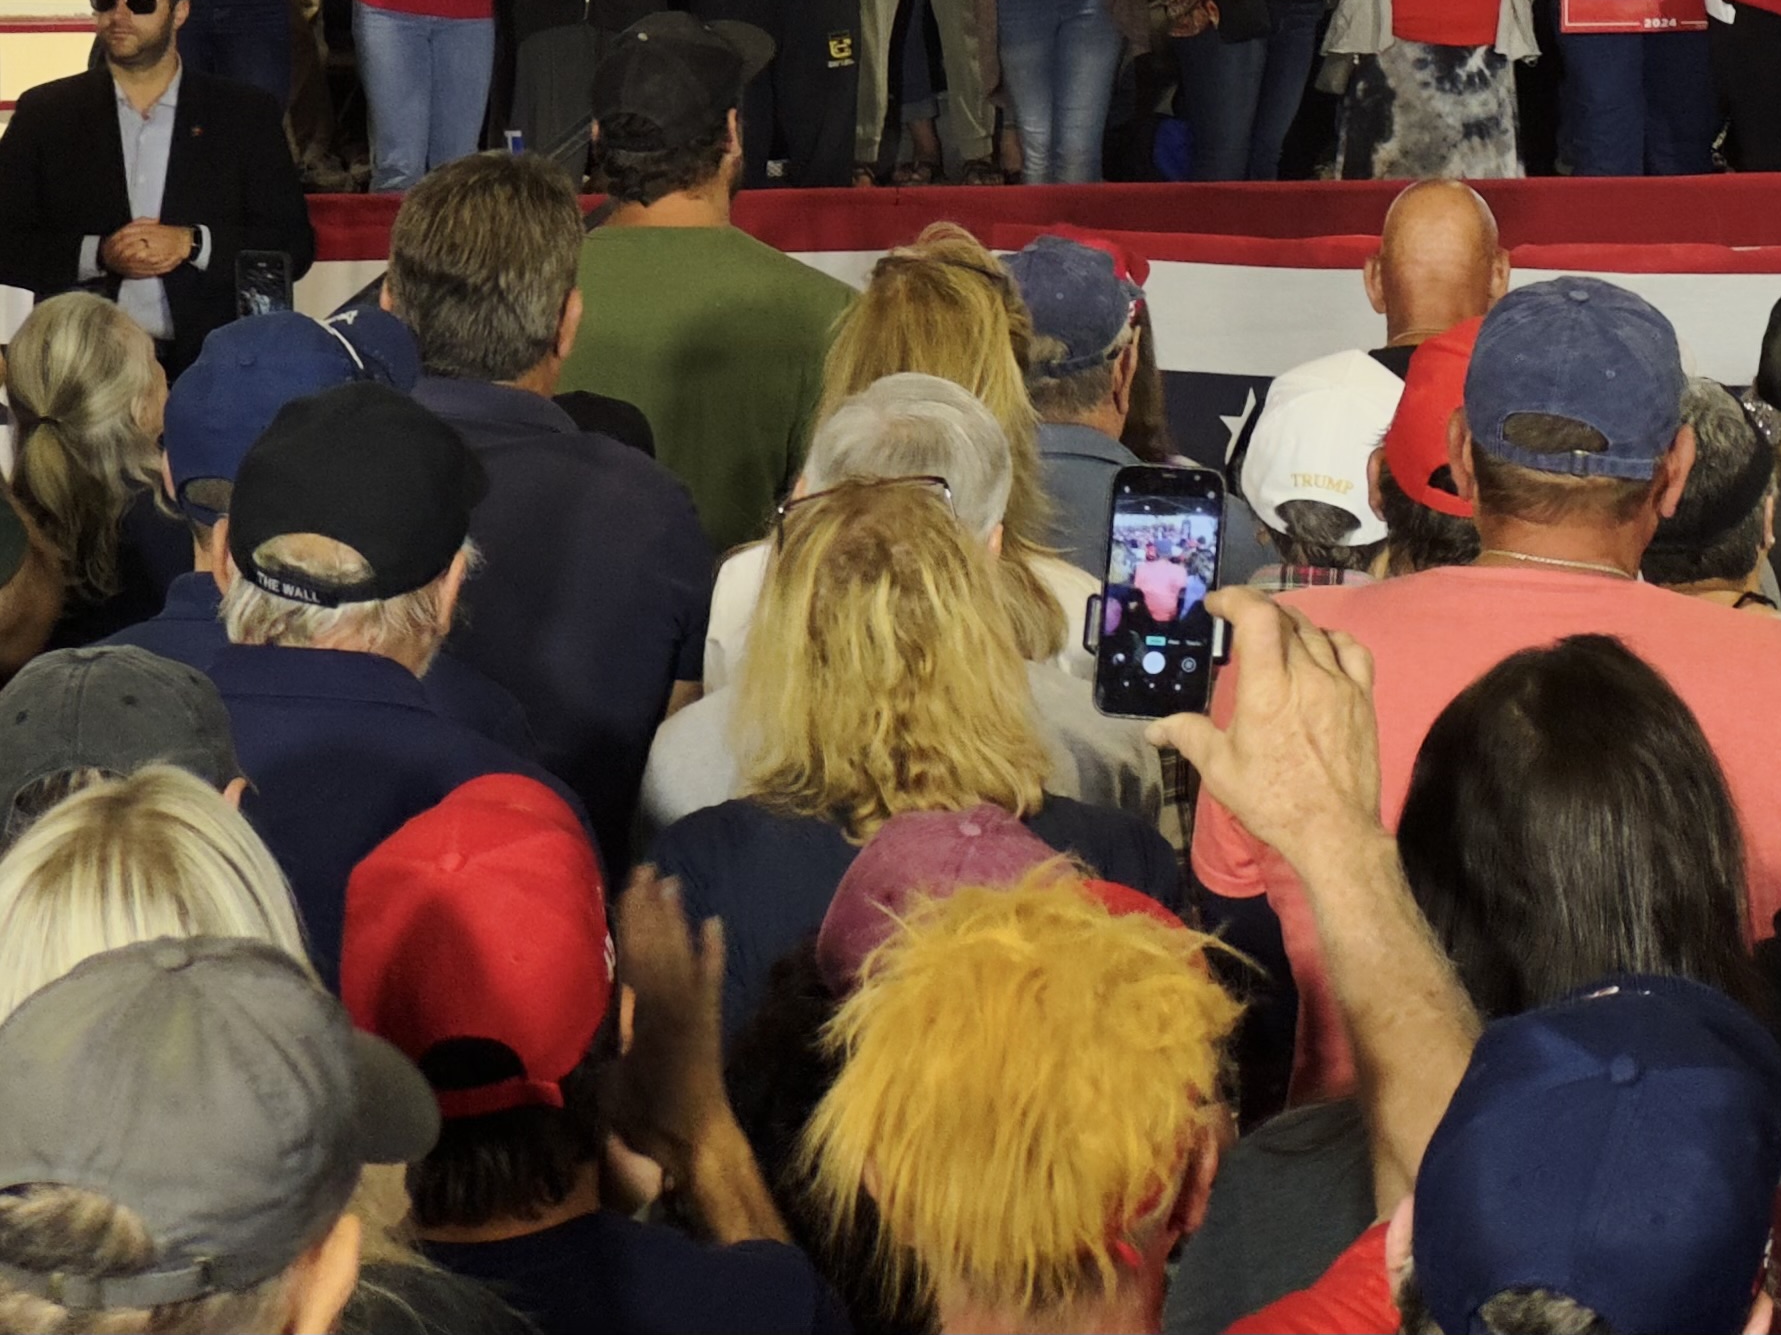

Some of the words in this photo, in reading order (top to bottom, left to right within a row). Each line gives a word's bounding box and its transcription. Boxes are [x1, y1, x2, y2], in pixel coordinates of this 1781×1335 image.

[1644, 18, 1677, 28] 2024
[1290, 472, 1354, 495] TRUMP
[257, 570, 280, 592] THE
[282, 583, 320, 603] WALL
